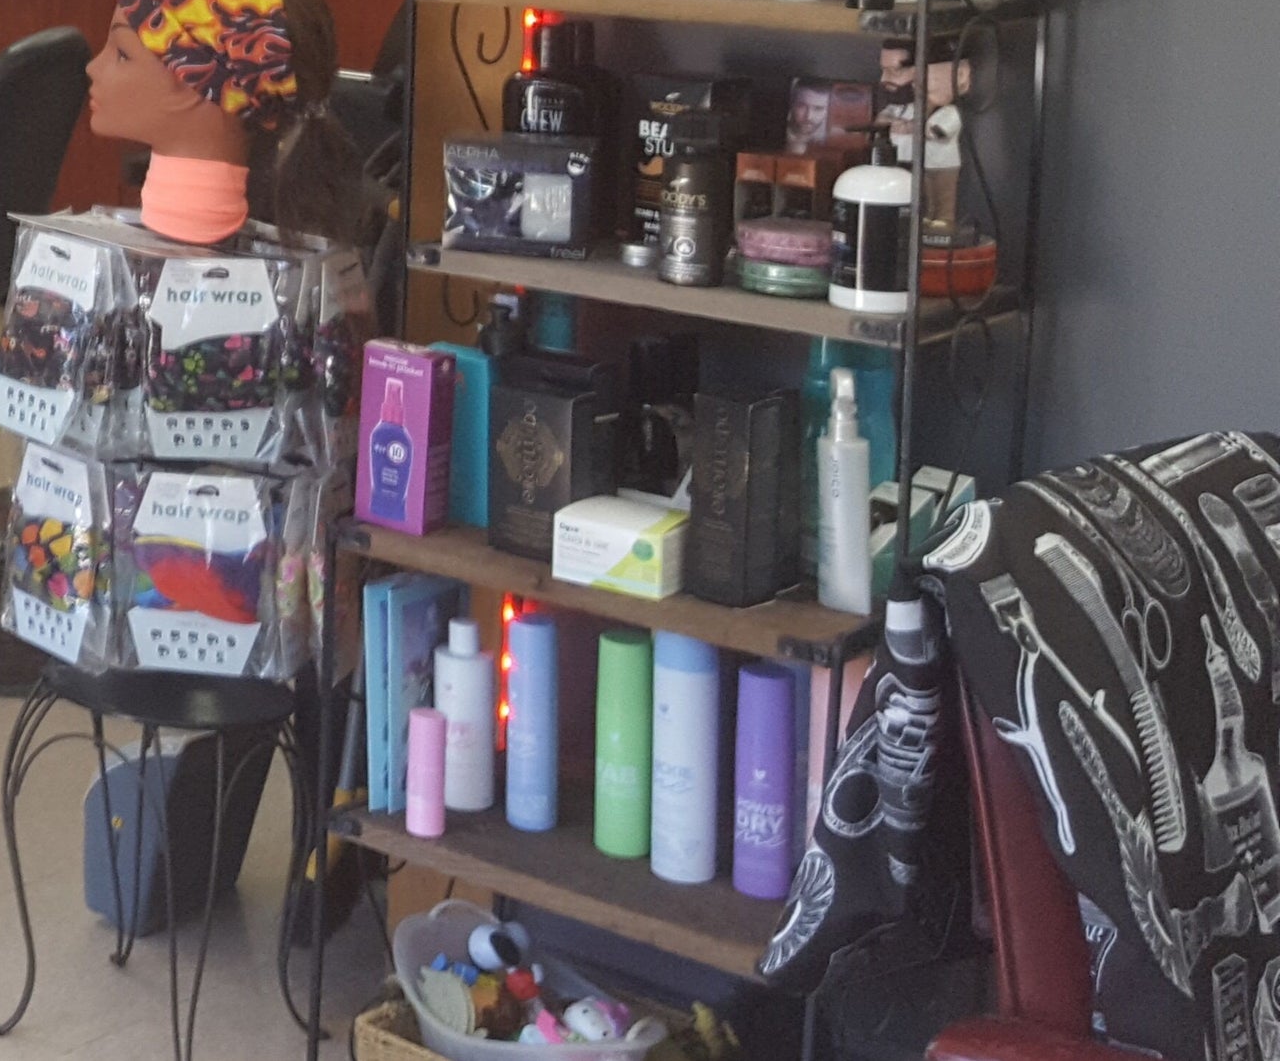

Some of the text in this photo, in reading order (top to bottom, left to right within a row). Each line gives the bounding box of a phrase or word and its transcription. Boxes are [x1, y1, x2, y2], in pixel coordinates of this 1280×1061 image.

[520, 109, 564, 132] CREW
[446, 145, 500, 160] ALPHA
[29, 262, 88, 292] hair wrap
[166, 287, 262, 306] hair wrap
[26, 471, 83, 507] hair wrap
[151, 501, 251, 525] hair wrap
